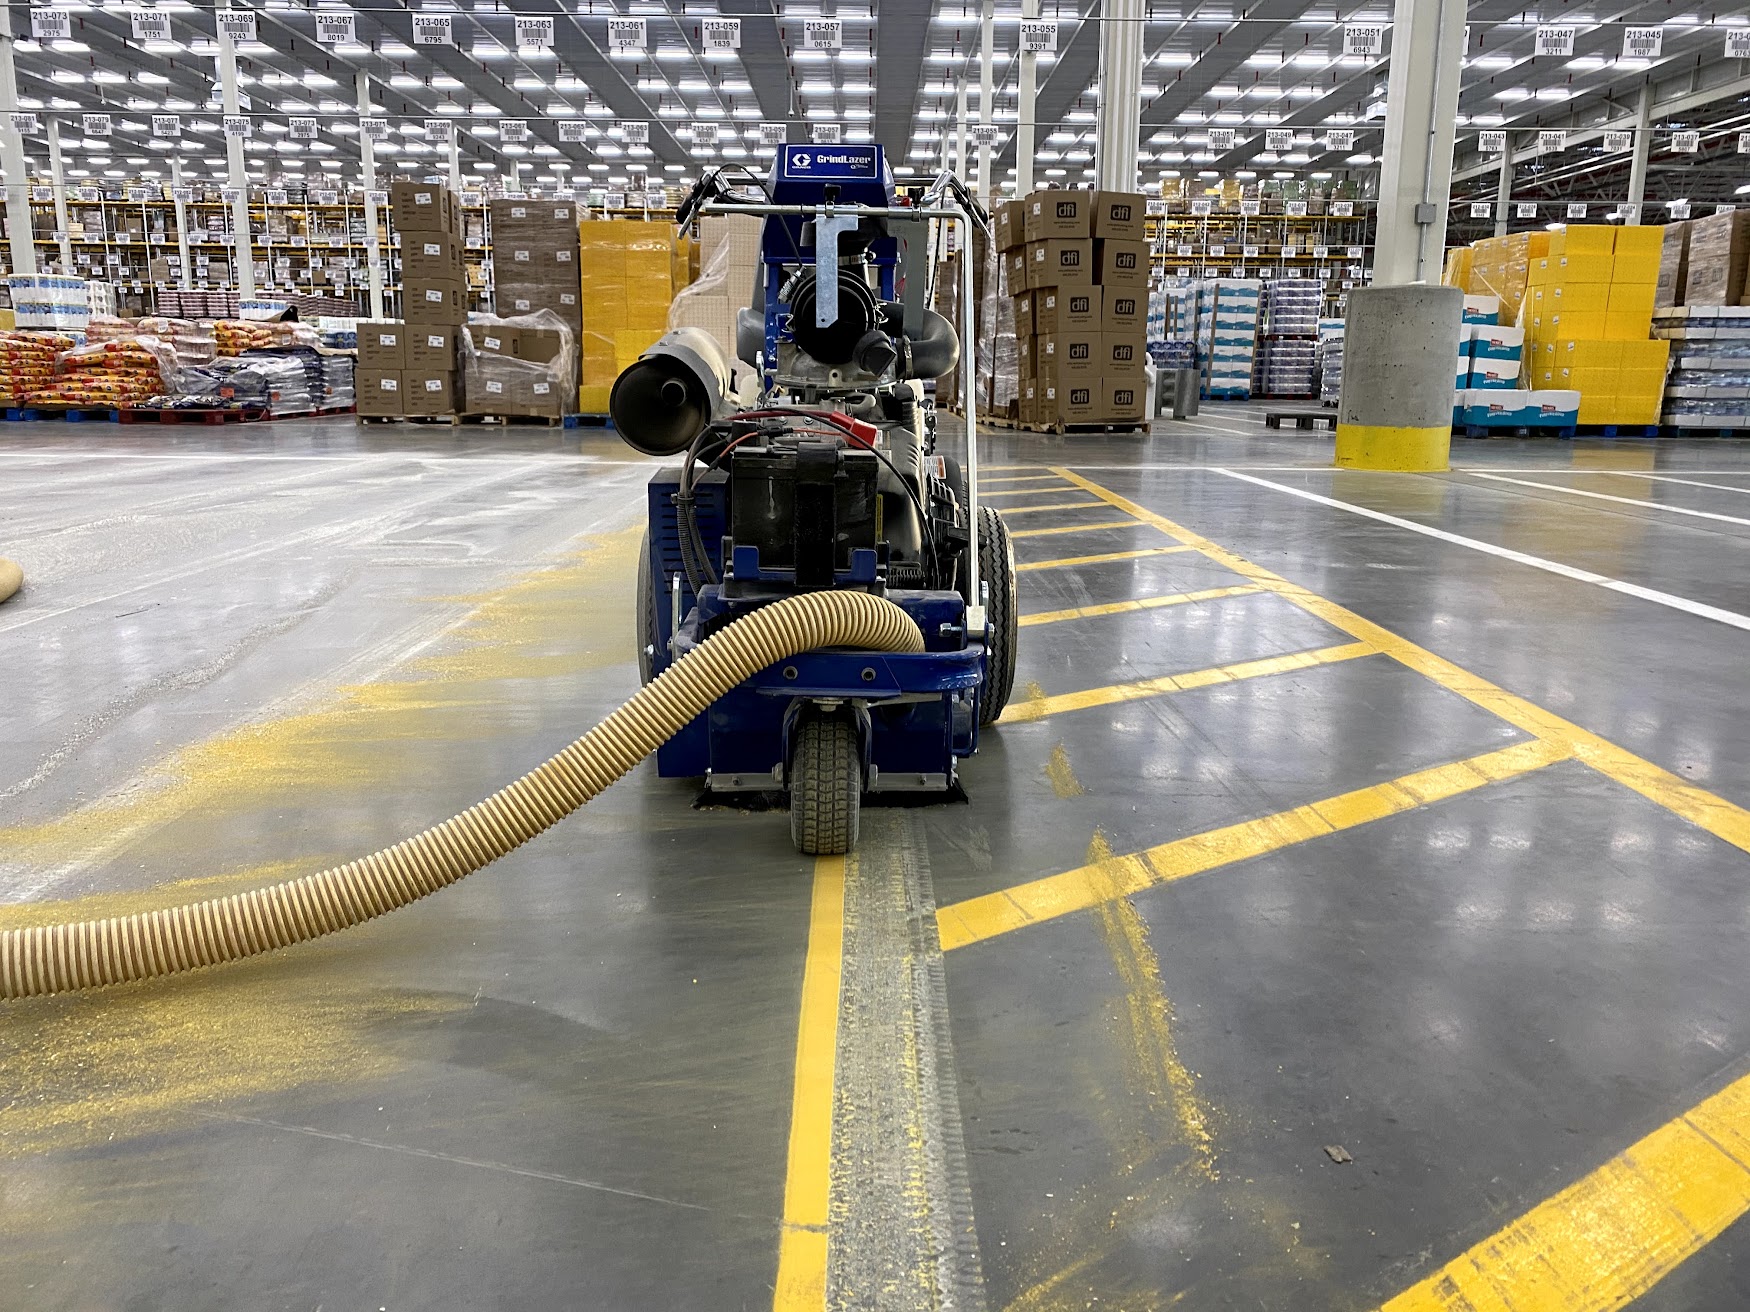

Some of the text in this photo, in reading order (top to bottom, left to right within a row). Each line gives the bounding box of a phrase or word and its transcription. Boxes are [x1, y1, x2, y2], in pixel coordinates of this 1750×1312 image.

[33, 12, 68, 20] 213-073
[134, 13, 167, 21] 213-071
[219, 14, 253, 22] 213-069
[318, 16, 352, 24] 213-067
[415, 18, 450, 26] 213-065
[610, 22, 643, 30] 213-061
[705, 22, 738, 30] 213-059
[1539, 30, 1573, 38] 213-047
[1728, 32, 1750, 40] 213-0
[817, 154, 871, 164] GrindLazer
[1058, 204, 1074, 216] dfi
[1112, 206, 1128, 219] dfi
[1062, 252, 1078, 264] dfi
[1118, 255, 1134, 267] dfi
[1072, 298, 1087, 311] dfi
[1117, 300, 1133, 313] dfi
[1072, 345, 1086, 357] dfi
[1115, 346, 1131, 359] dfi
[1072, 390, 1087, 403] dfi
[1116, 391, 1132, 404] dfi
